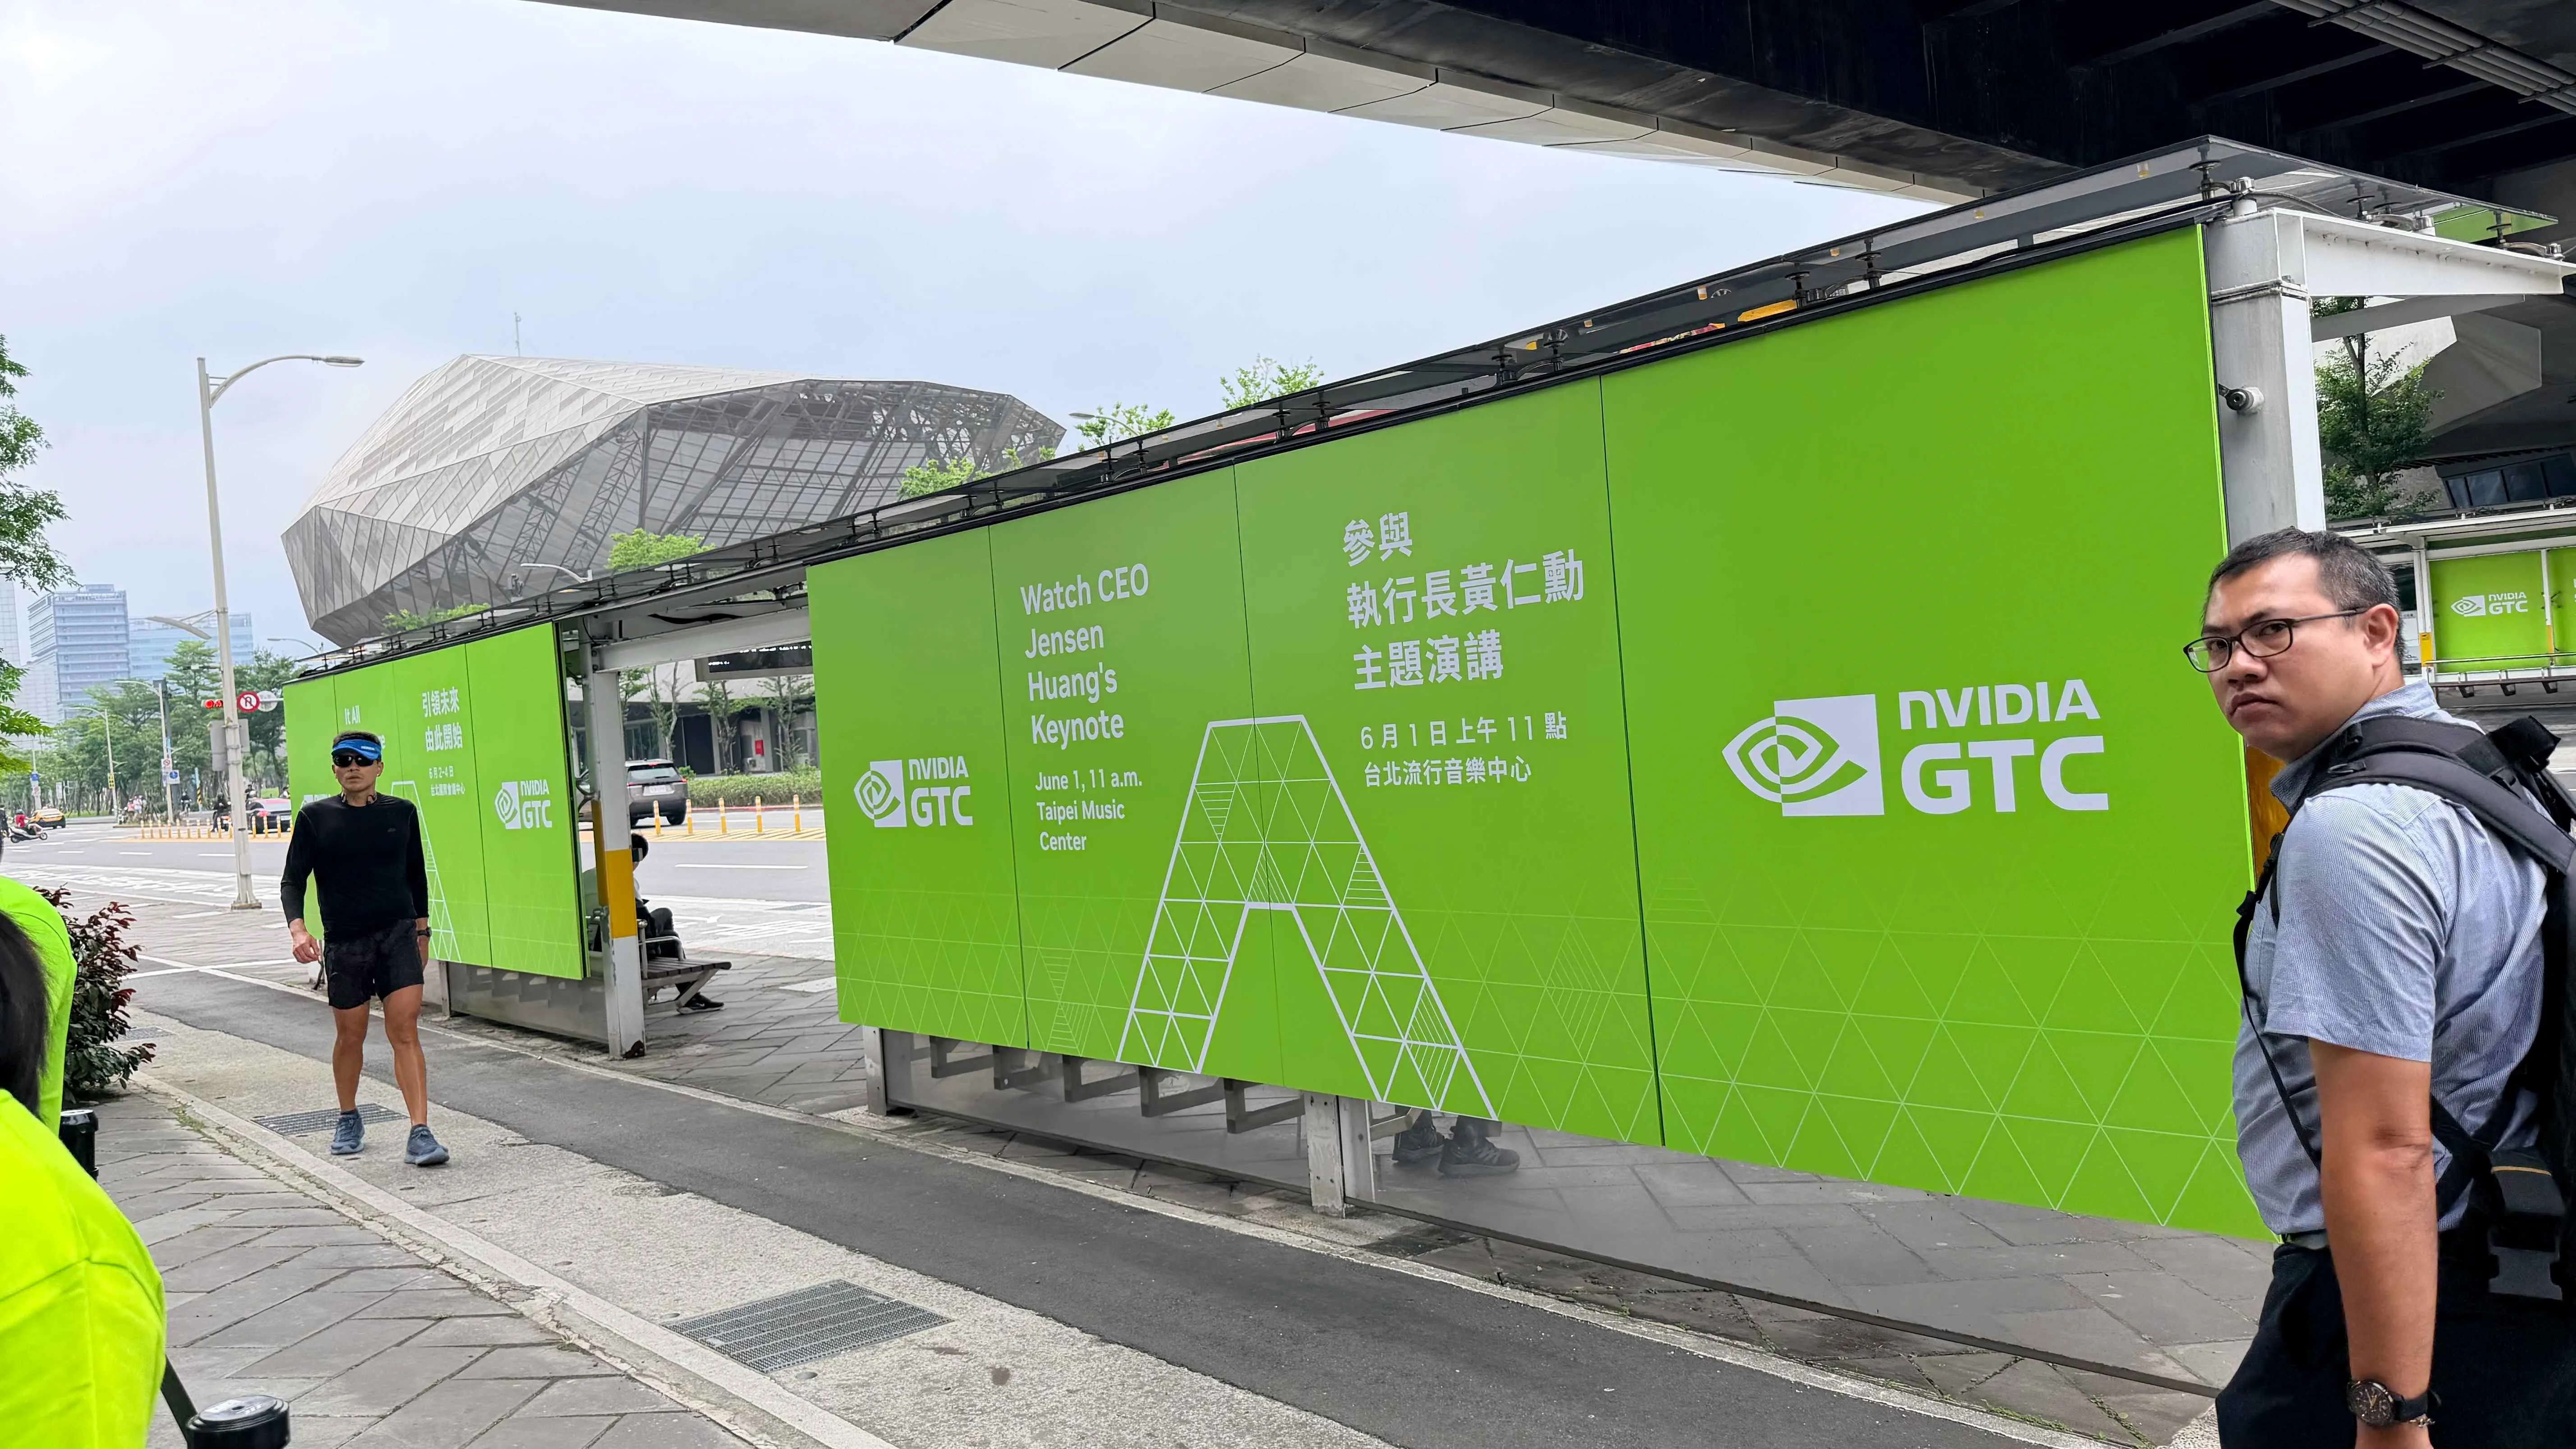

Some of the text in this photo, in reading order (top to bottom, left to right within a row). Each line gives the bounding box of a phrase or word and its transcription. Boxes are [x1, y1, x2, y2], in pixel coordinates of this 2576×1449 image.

[1343, 511, 1412, 566] 參與
[1021, 563, 1148, 615] Watch CEO
[2489, 601, 2528, 614] GTC
[1025, 626, 1104, 658] Jensen
[1354, 629, 1503, 689] 主題演講
[1028, 662, 1117, 703] Huang's
[345, 705, 360, 724] It All
[422, 687, 459, 717] 引領未來
[426, 723, 462, 751] 由此開始
[1032, 711, 1123, 750] Keynote
[1035, 769, 1142, 792] June 1, 11 a.m.
[1365, 756, 1531, 787] 台北流行音樂中心
[1901, 736, 2108, 814] GTC
[521, 800, 552, 829] GTC
[911, 786, 973, 827] GTC
[1037, 799, 1124, 824] Taipei Music
[1040, 832, 1086, 850] Center
